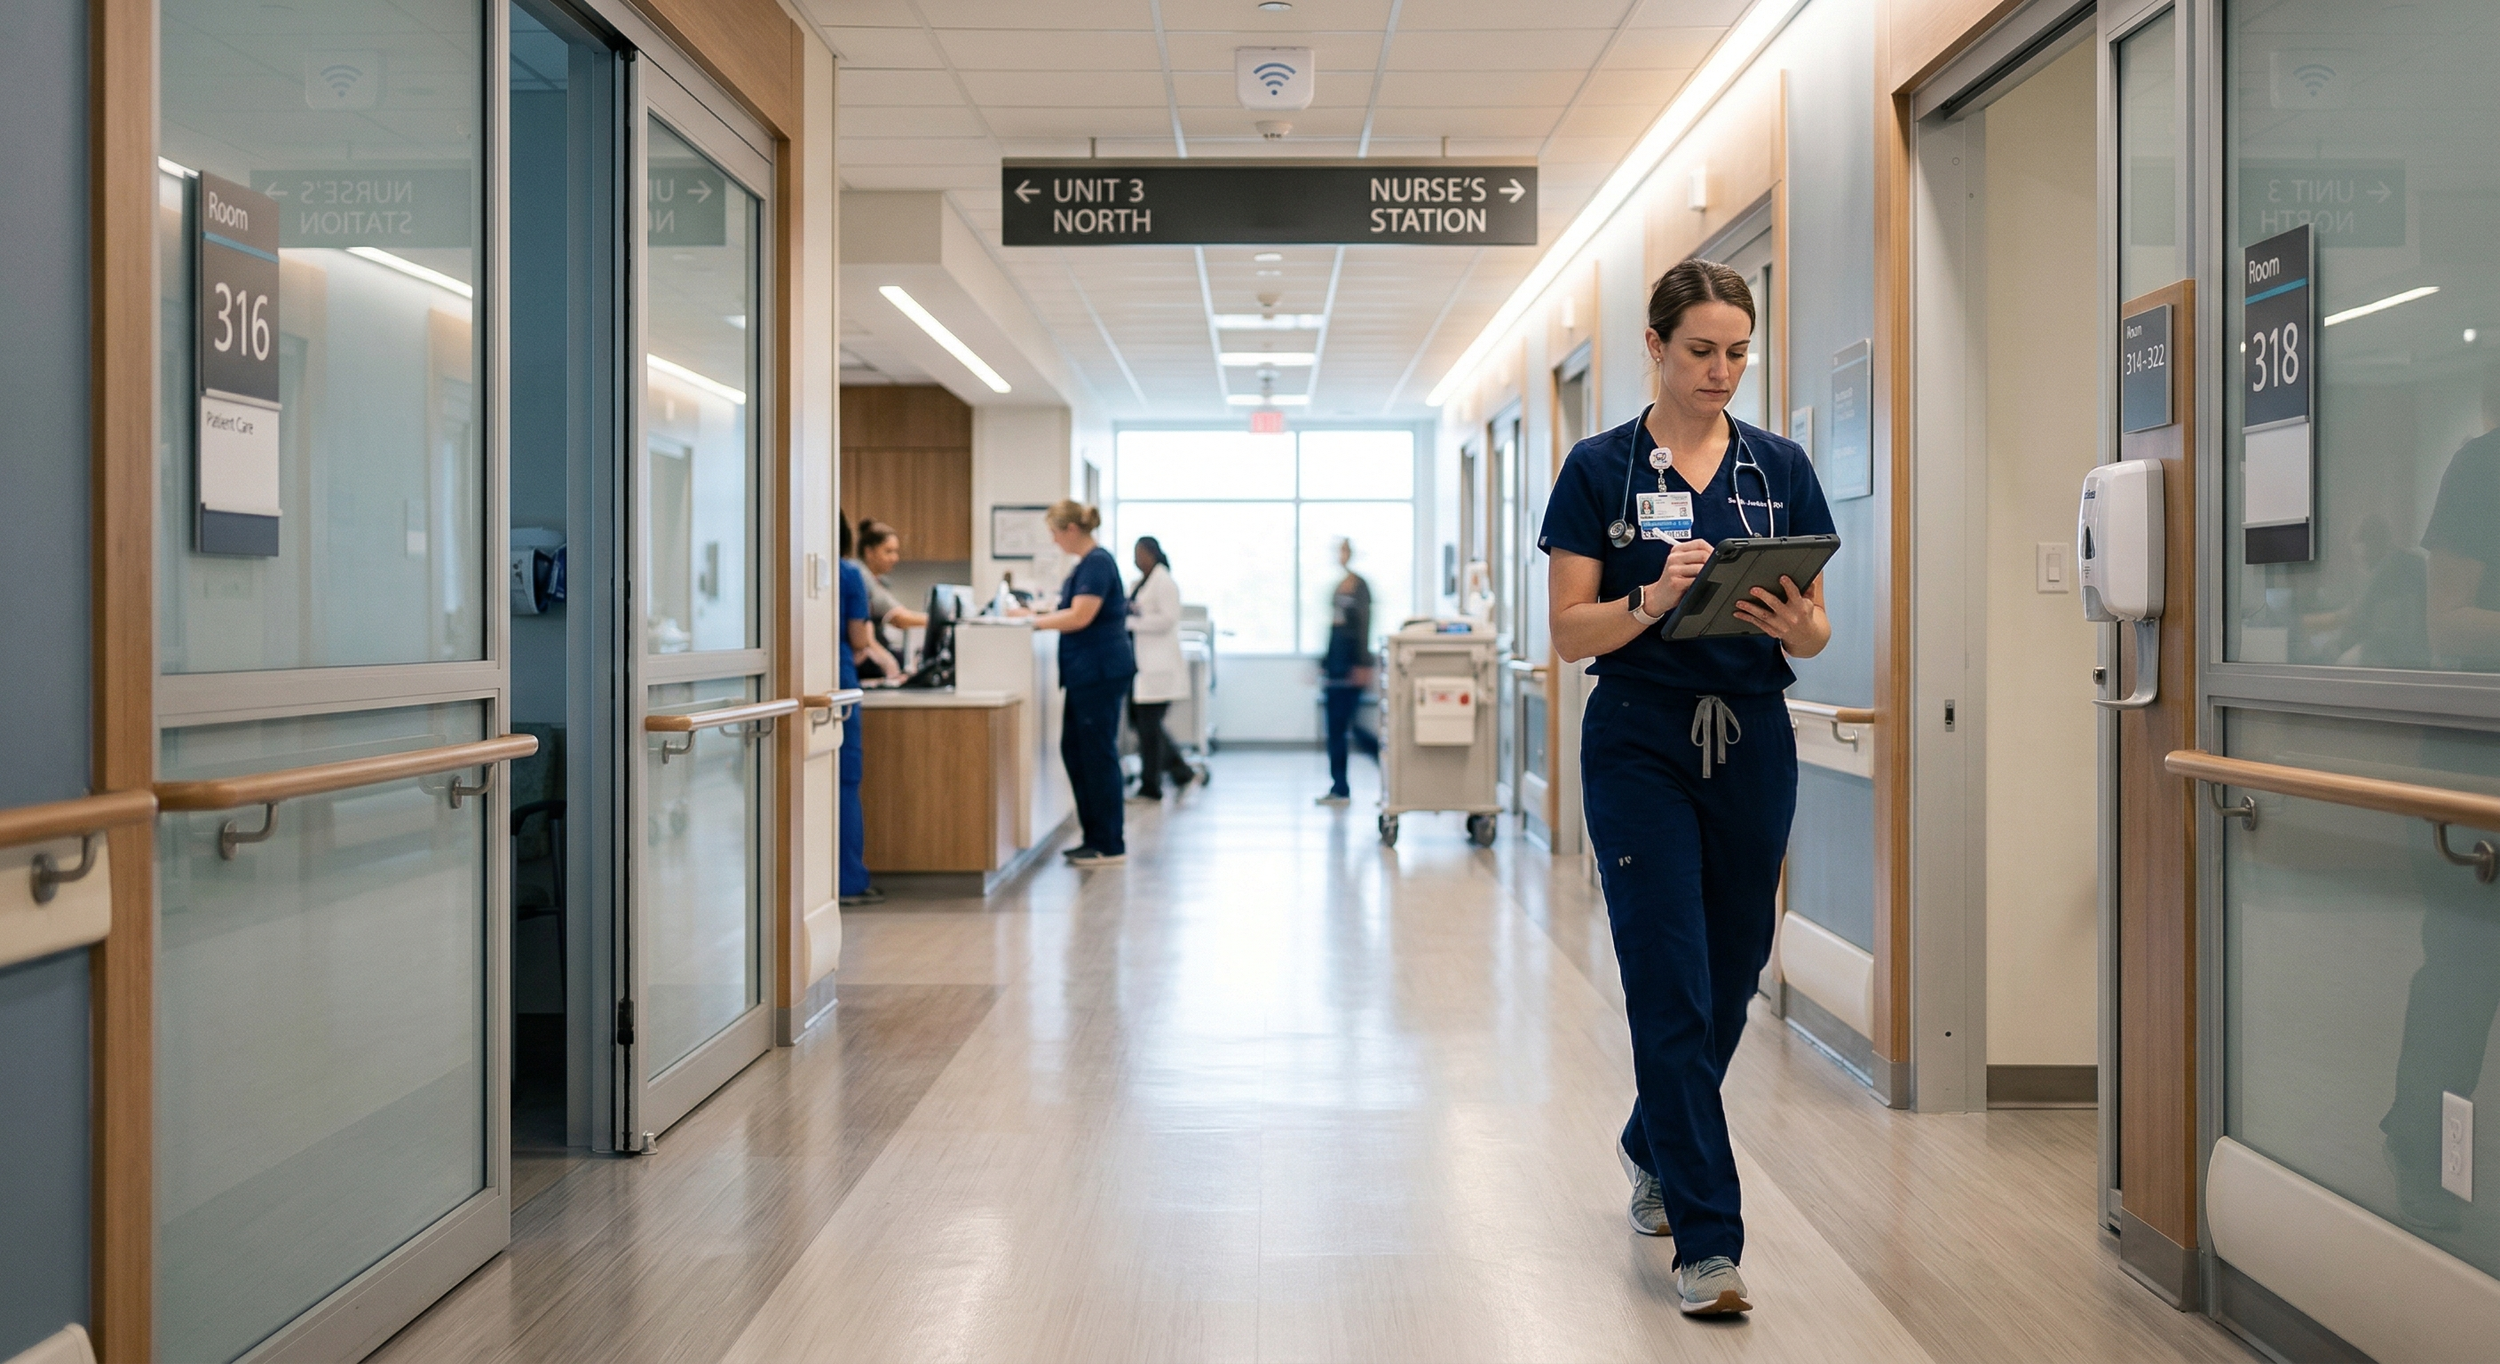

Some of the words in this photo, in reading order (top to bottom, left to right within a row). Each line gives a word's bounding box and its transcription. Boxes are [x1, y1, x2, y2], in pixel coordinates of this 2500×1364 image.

[1053, 178, 1120, 203] UNIT
[1128, 178, 1145, 203] 3
[1370, 177, 1487, 203] NURSE'S
[208, 191, 249, 231] Room
[1053, 208, 1151, 233] NORTH
[1370, 208, 1487, 233] STATION
[2248, 256, 2280, 285] Room
[214, 281, 270, 362] 316
[2126, 343, 2165, 375] 314-322
[2252, 321, 2299, 393] 318
